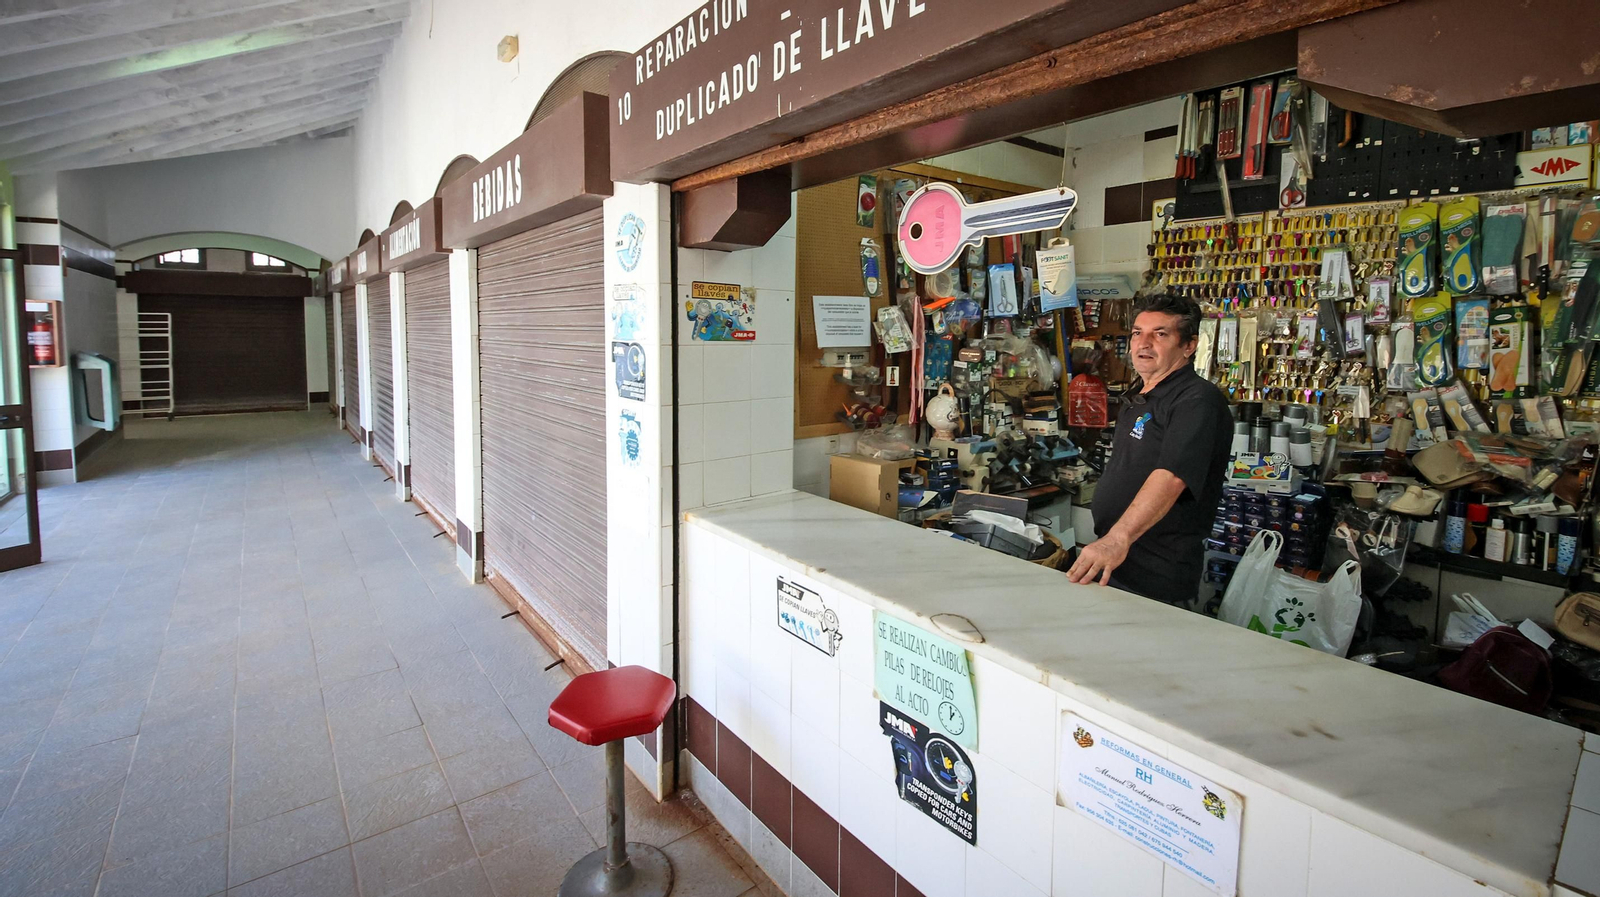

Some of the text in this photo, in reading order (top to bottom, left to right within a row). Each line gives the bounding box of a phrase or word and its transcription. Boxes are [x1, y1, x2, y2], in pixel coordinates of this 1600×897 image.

[656, 54, 759, 140] DUPLICADO
[773, 29, 801, 81] DE
[618, 91, 631, 125] 10
[1531, 157, 1581, 177] JMA
[472, 154, 522, 223] BEBIDAS
[698, 289, 726, 298] llaves
[707, 284, 739, 293] copian
[784, 597, 800, 611] COPIAN
[800, 606, 816, 619] LLAVES
[878, 621, 887, 640] SE
[889, 625, 927, 658] REALIZAN
[884, 650, 955, 701] PILAS DE RELOJES
[895, 683, 929, 717] AL ACTO
[884, 711, 917, 740] JMA
[1094, 766, 1126, 786] Manuel
[1100, 737, 1193, 787] REFORMAS EN GENERAL
[1135, 767, 1153, 784] RH
[907, 782, 973, 831] COPIED FOR CARS AND
[912, 777, 973, 822] TRANSPONDER KEYS
[931, 808, 973, 840] MOTORBIKES
